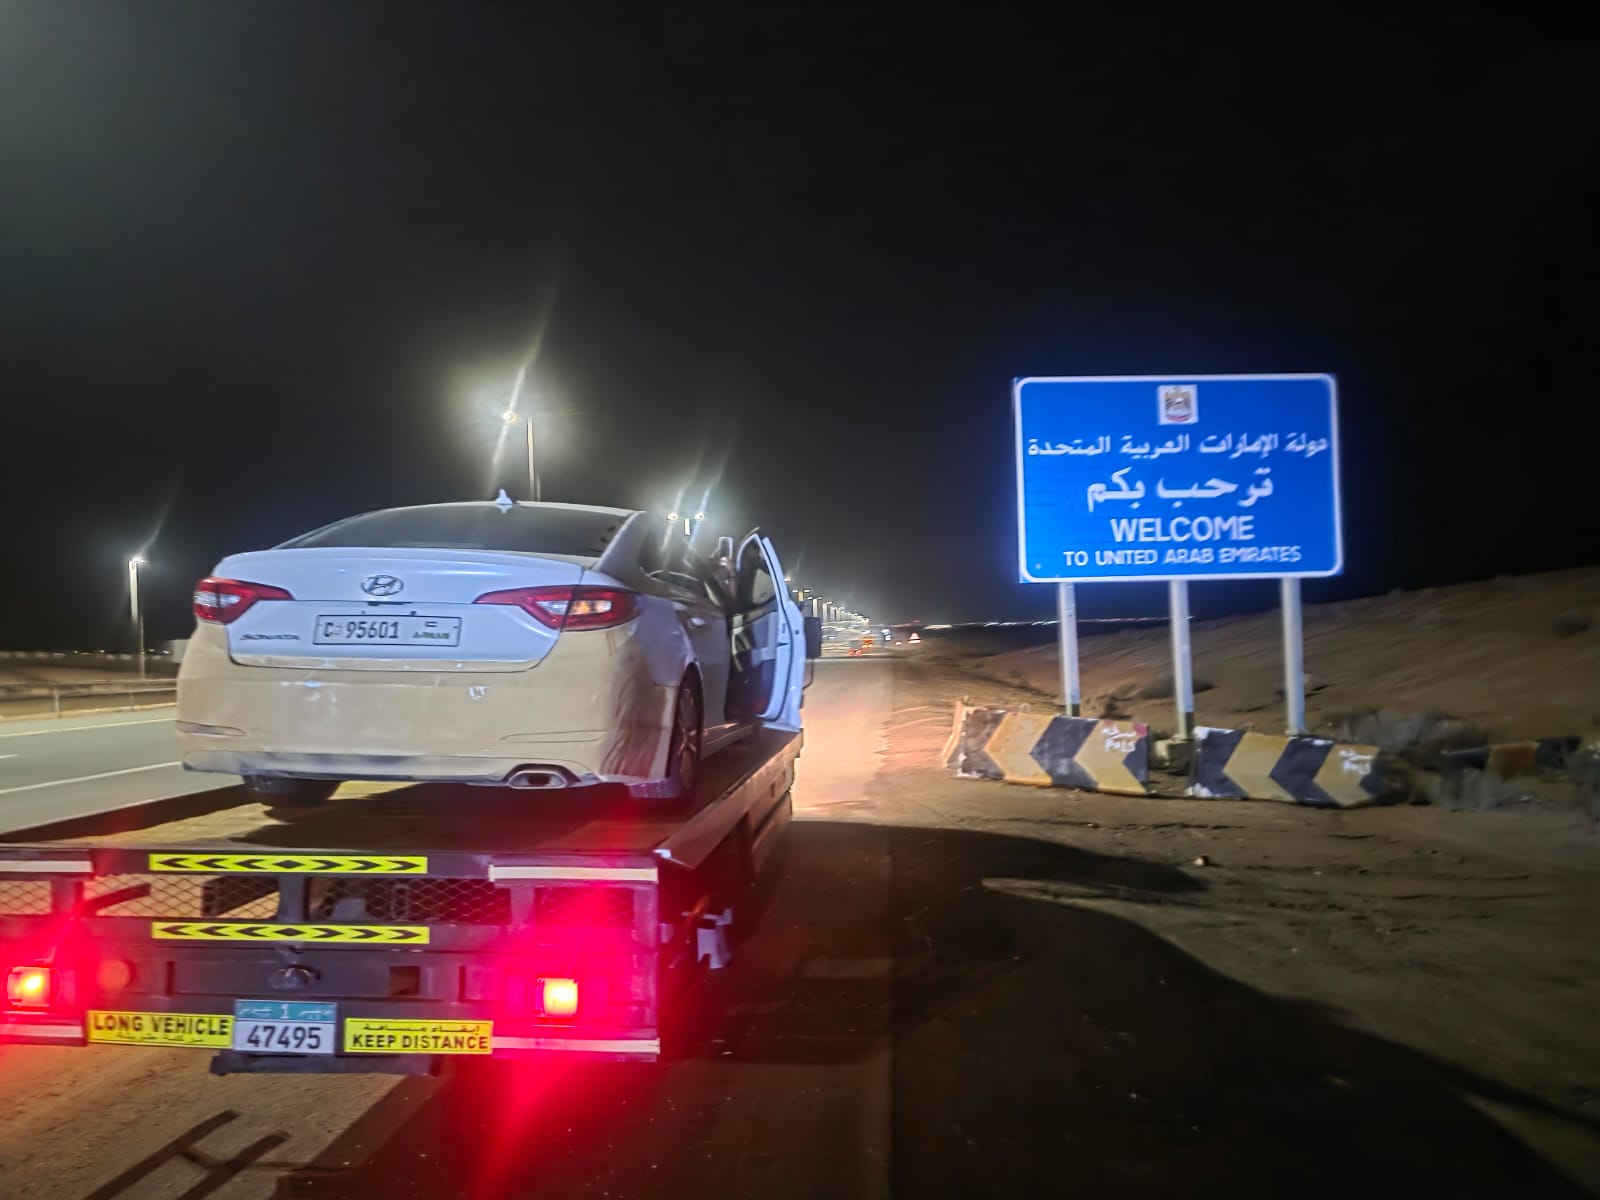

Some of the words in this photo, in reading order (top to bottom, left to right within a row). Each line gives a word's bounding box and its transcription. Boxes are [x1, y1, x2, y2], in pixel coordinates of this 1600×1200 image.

[1028, 435, 1111, 456] المتحدة
[1119, 433, 1190, 459] العربية
[1284, 432, 1328, 458] دولة
[1087, 467, 1146, 513] بكم
[1110, 515, 1255, 543] WELCOME
[1063, 550, 1089, 566] TO
[1095, 549, 1158, 566] UNITED
[1164, 547, 1213, 564] ARAB
[1219, 545, 1302, 563] EMIRATES
[345, 621, 399, 639] 95601
[280, 1003, 290, 1019] 1
[94, 1014, 143, 1032] LONG
[151, 1016, 230, 1036] VEHICLE
[246, 1025, 322, 1050] 47495
[352, 1034, 396, 1048] KEEP
[401, 1035, 489, 1050] DISTANCE
